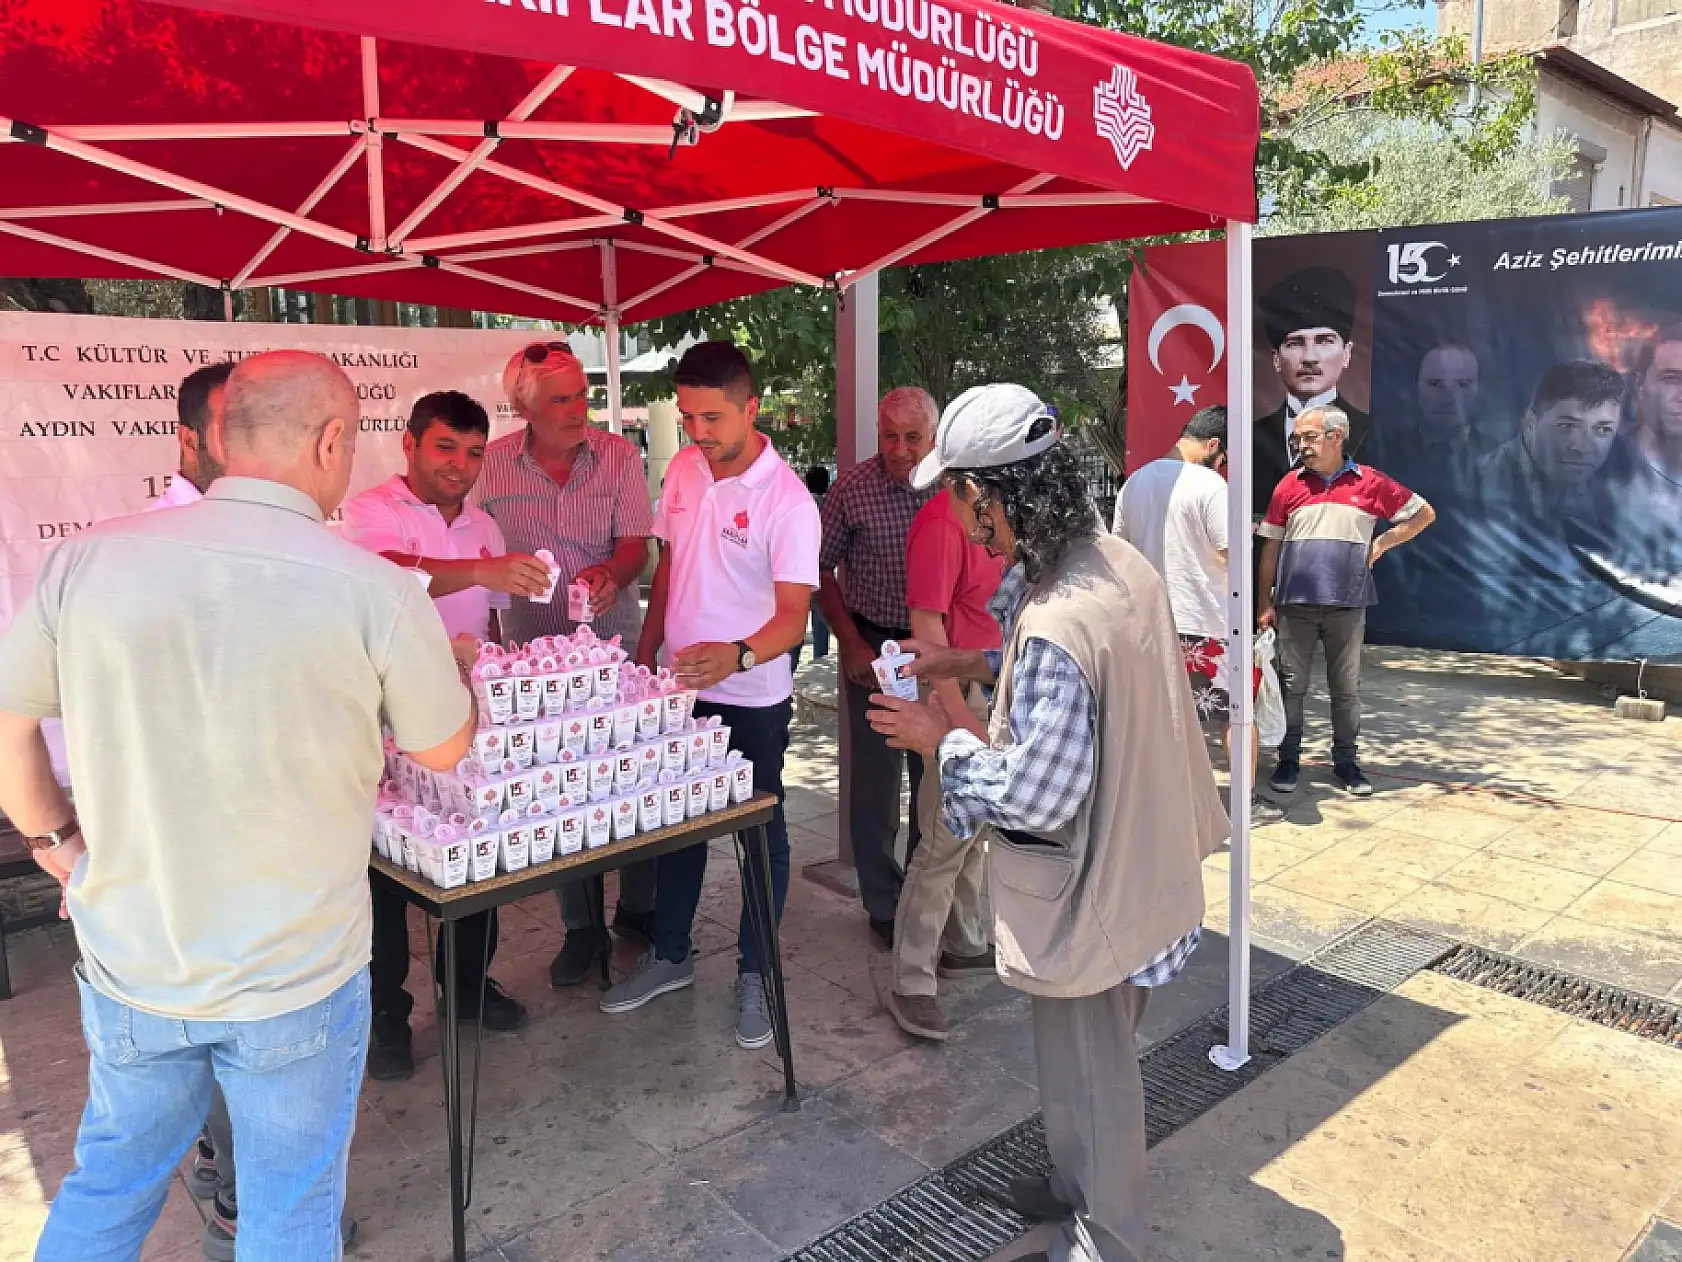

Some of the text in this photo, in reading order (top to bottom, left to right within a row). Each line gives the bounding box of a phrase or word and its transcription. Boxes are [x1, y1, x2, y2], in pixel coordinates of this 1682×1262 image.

[706, 0, 850, 79] BÖLGE
[857, 40, 1065, 141] MÜDÜRLÜĞÜ
[1492, 239, 1682, 271] Aziz Şehitlerimi
[22, 345, 60, 361] T.C
[76, 344, 168, 363] KÜLTÜR
[183, 349, 210, 365] VE
[320, 351, 419, 368] AKANLIĞI
[62, 384, 177, 400] VAKIFLAR
[20, 420, 180, 437] AYDIN VAKIF
